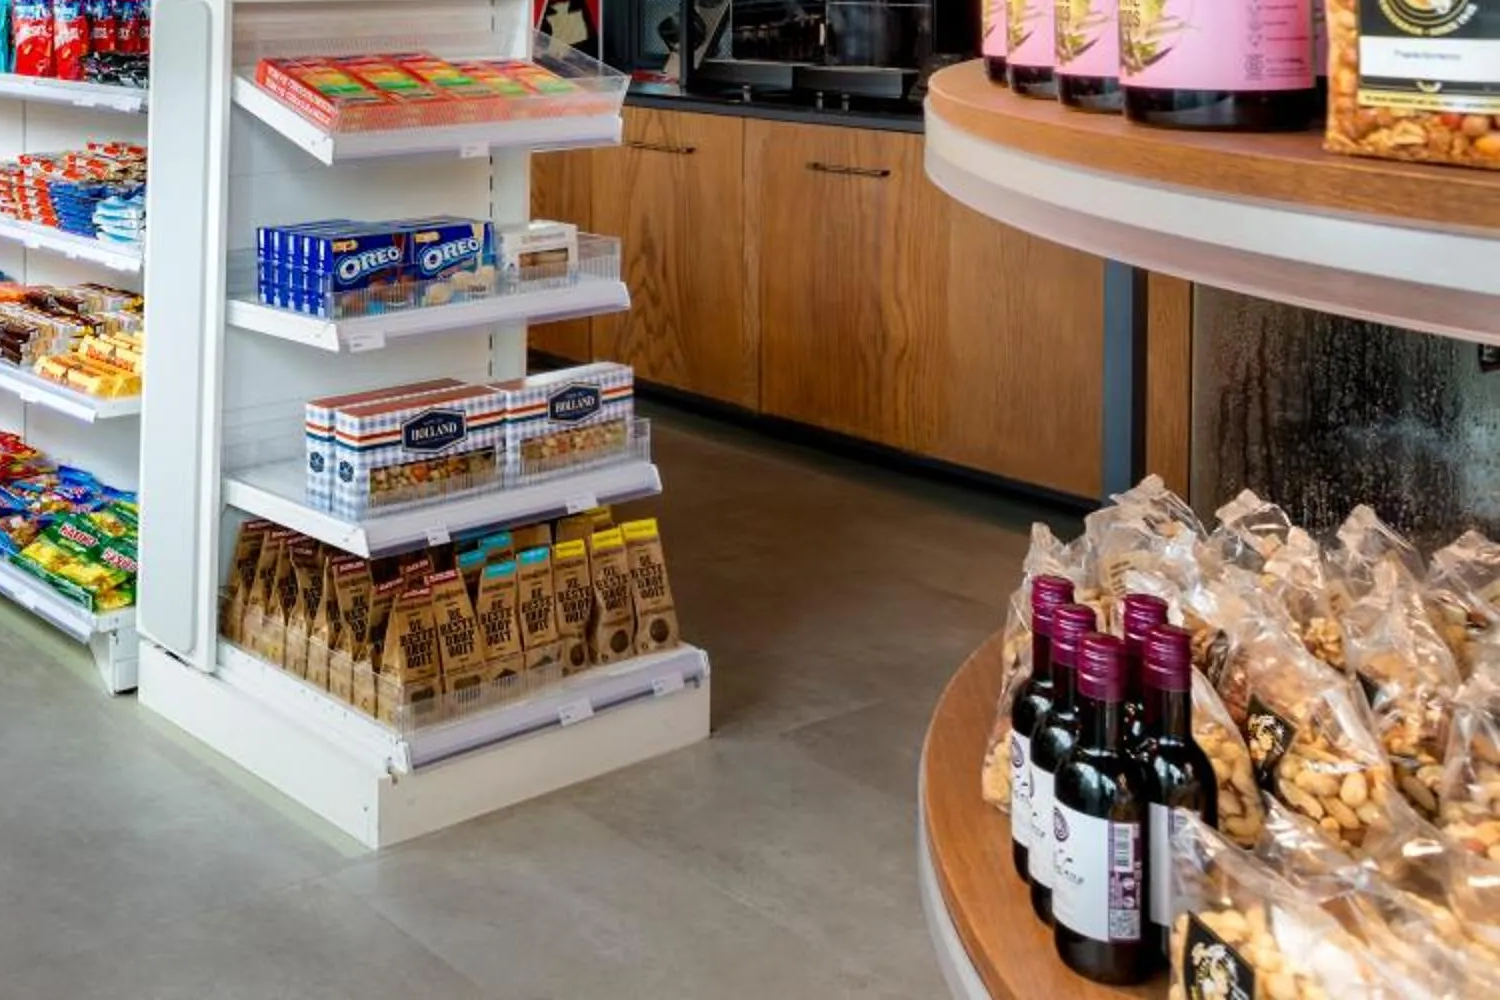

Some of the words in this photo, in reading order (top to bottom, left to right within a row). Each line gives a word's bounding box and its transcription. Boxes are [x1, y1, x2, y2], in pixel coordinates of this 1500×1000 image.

[339, 247, 401, 280] OREO
[423, 238, 480, 270] OREO
[555, 395, 596, 414] HOLLAND
[411, 422, 457, 441] HOLLAND
